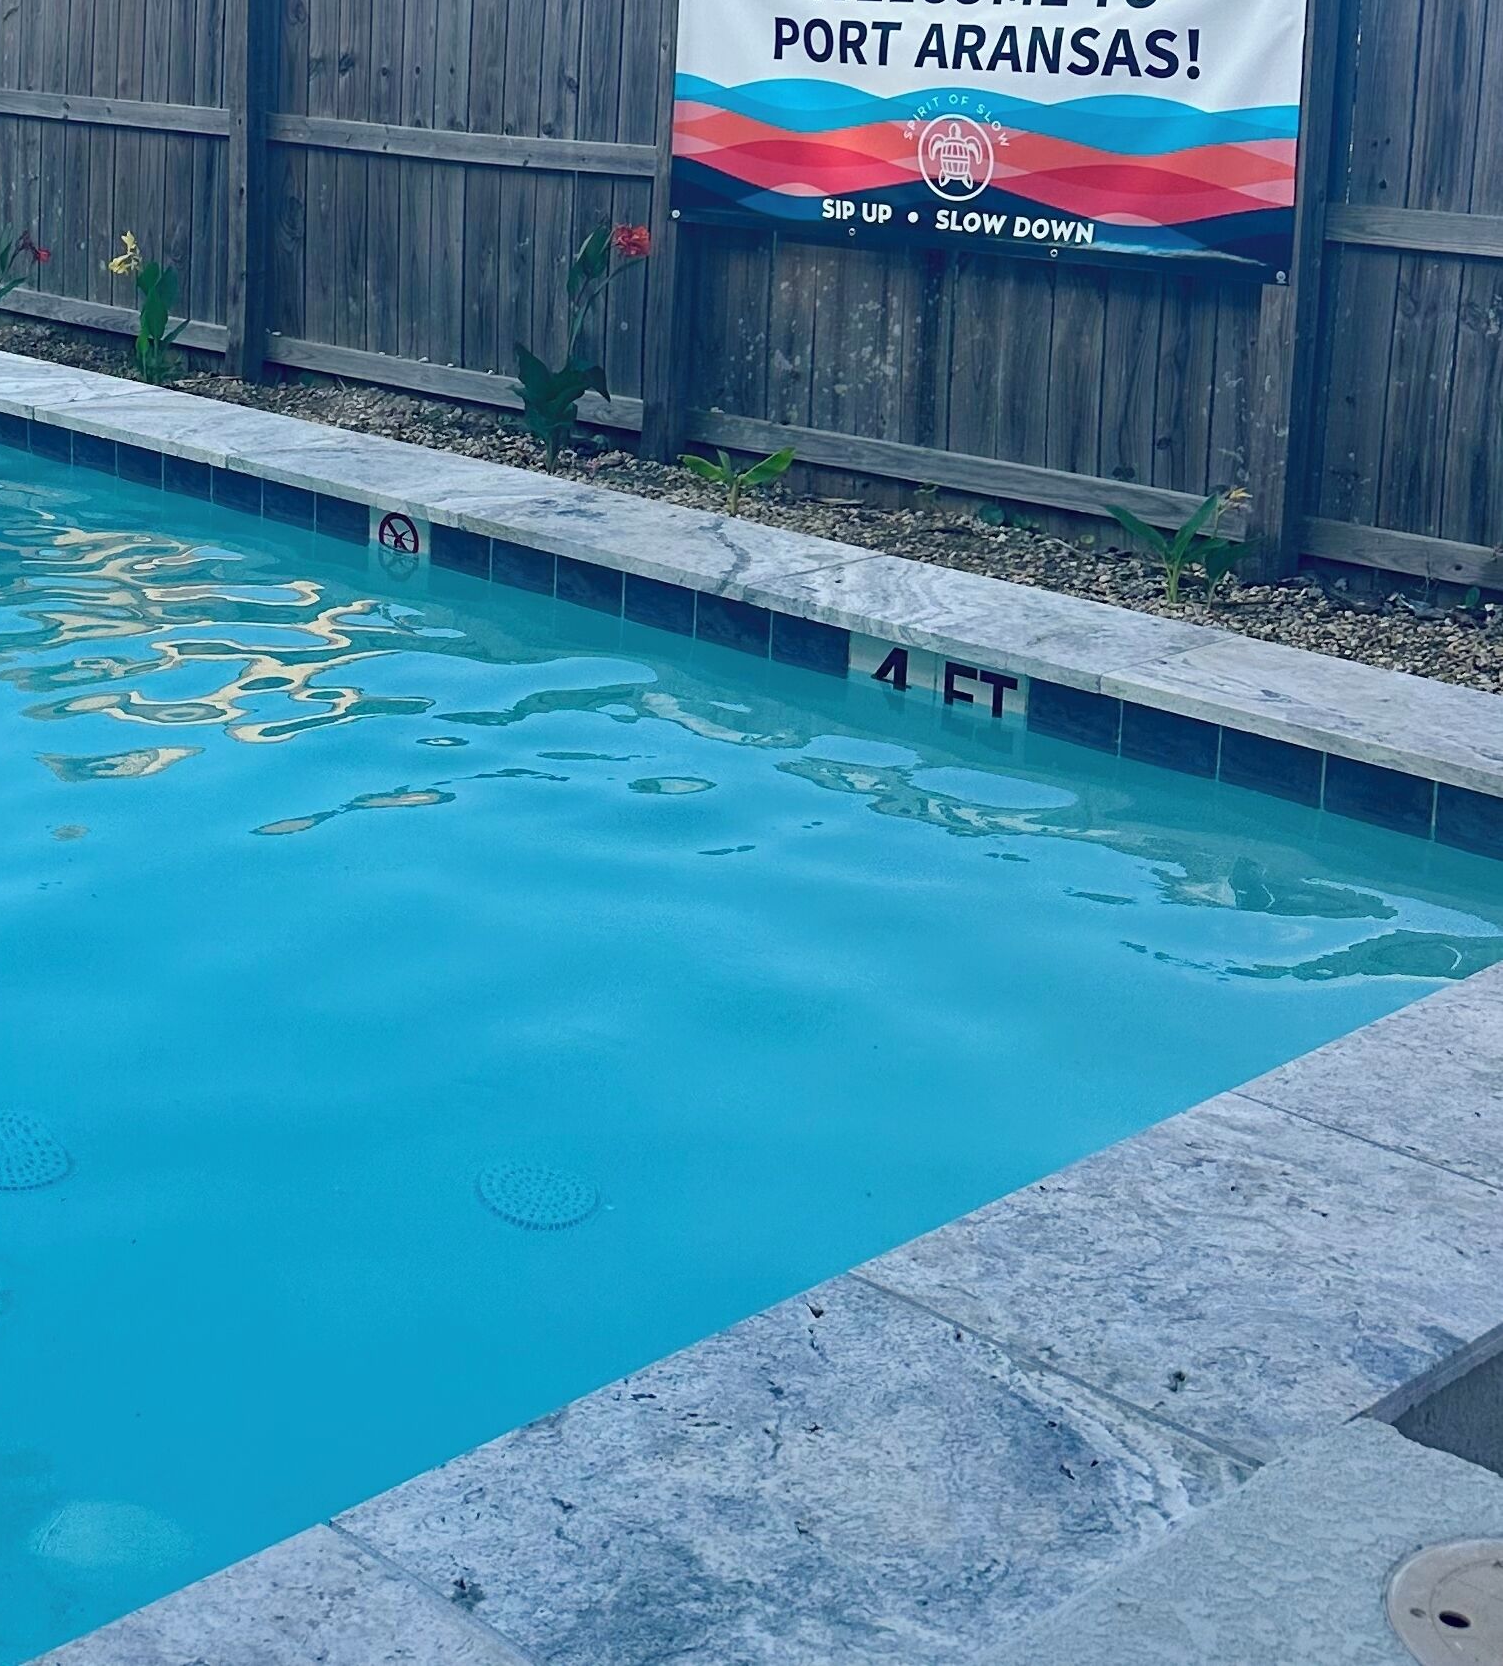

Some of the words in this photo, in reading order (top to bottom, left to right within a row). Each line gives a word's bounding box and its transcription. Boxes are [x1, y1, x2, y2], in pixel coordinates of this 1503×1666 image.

[772, 16, 903, 66] PORT
[914, 22, 1202, 80] ARANSAS!
[903, 96, 939, 141] SPIRIT
[948, 93, 970, 107] OF
[976, 103, 1011, 148] SLOW
[821, 198, 856, 221] SIP
[861, 202, 893, 224] UP
[934, 209, 1008, 235] SLOW
[1012, 216, 1095, 245] DOWN
[870, 646, 913, 693] 4
[943, 660, 1019, 719] FT
